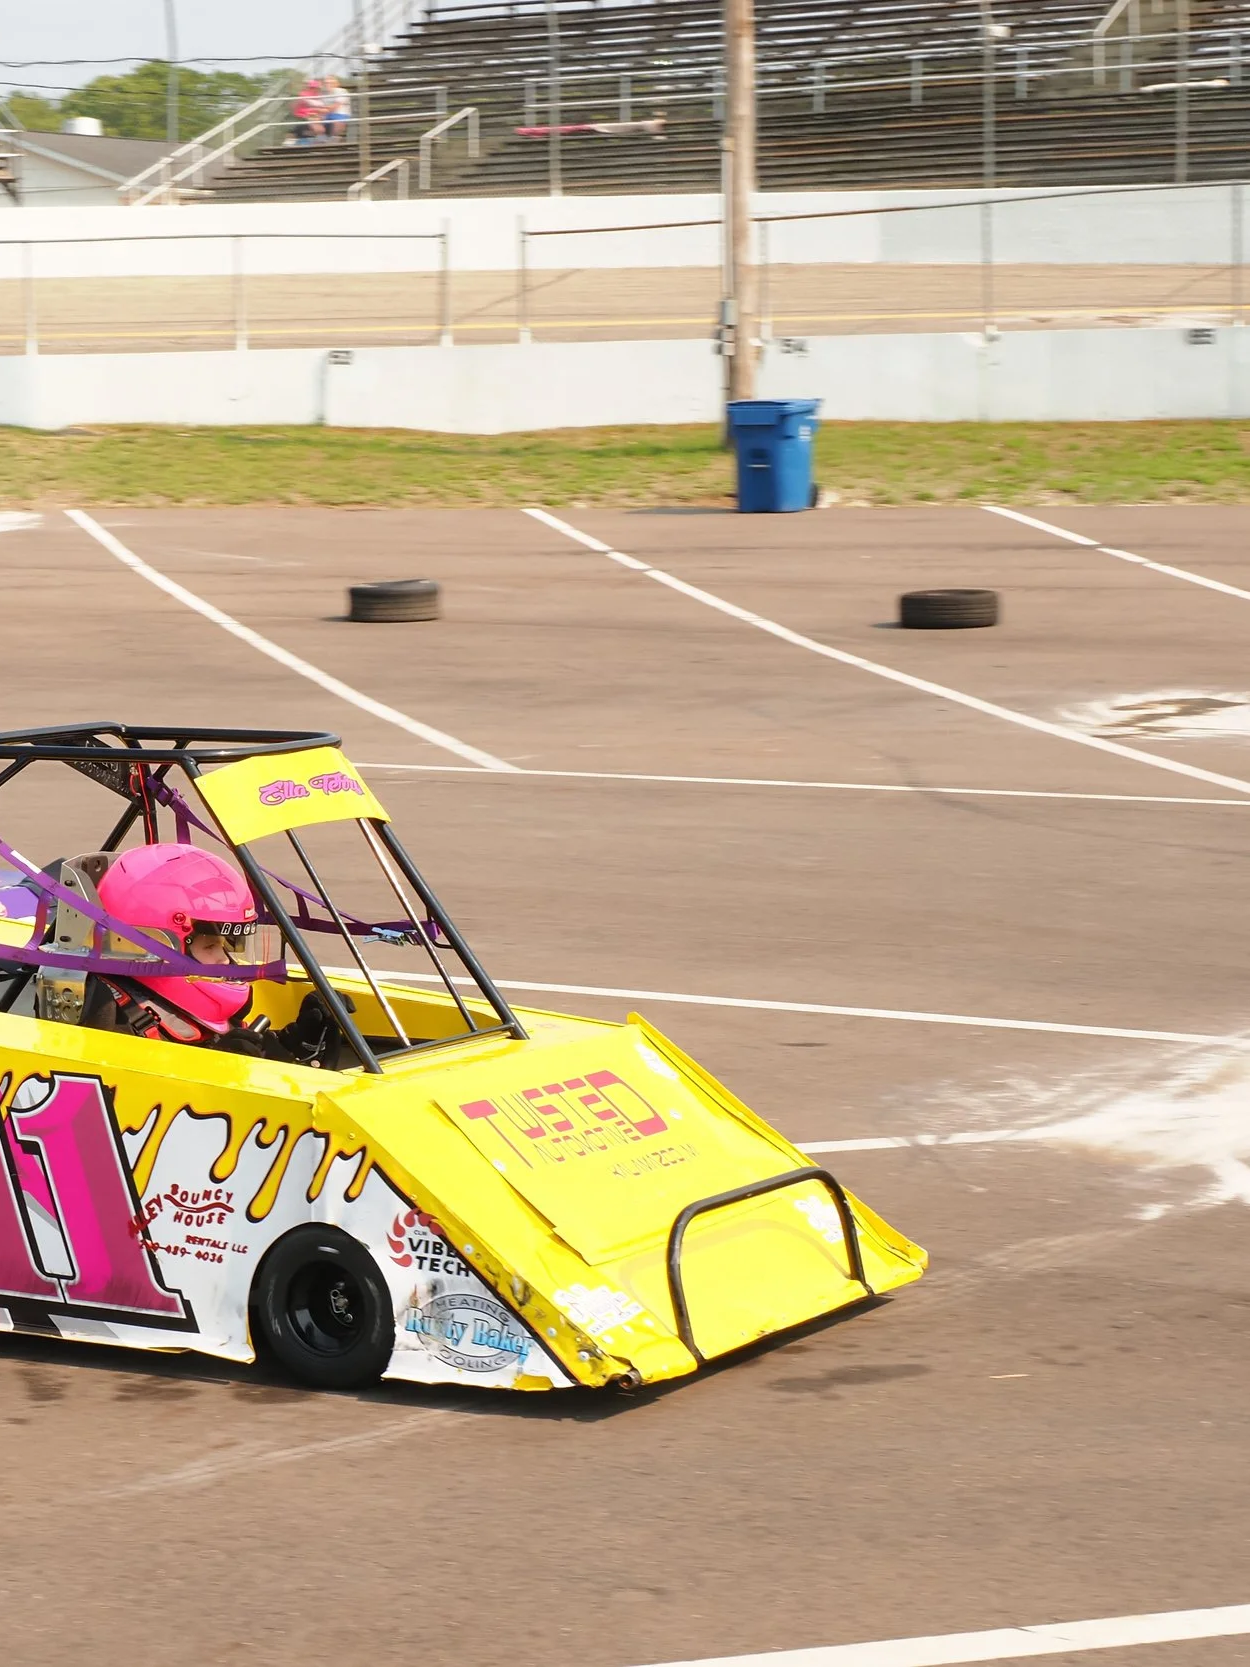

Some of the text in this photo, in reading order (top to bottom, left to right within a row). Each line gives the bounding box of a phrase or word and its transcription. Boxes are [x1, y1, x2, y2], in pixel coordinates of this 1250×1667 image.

[259, 780, 310, 806] Ella
[170, 1183, 234, 1205] BOUNCY
[173, 1211, 227, 1228] HOUSE
[185, 1235, 248, 1254] RENTALS LLC
[415, 1255, 471, 1277] TECH
[435, 1297, 511, 1323] HEATING
[472, 1317, 534, 1358] Baker
